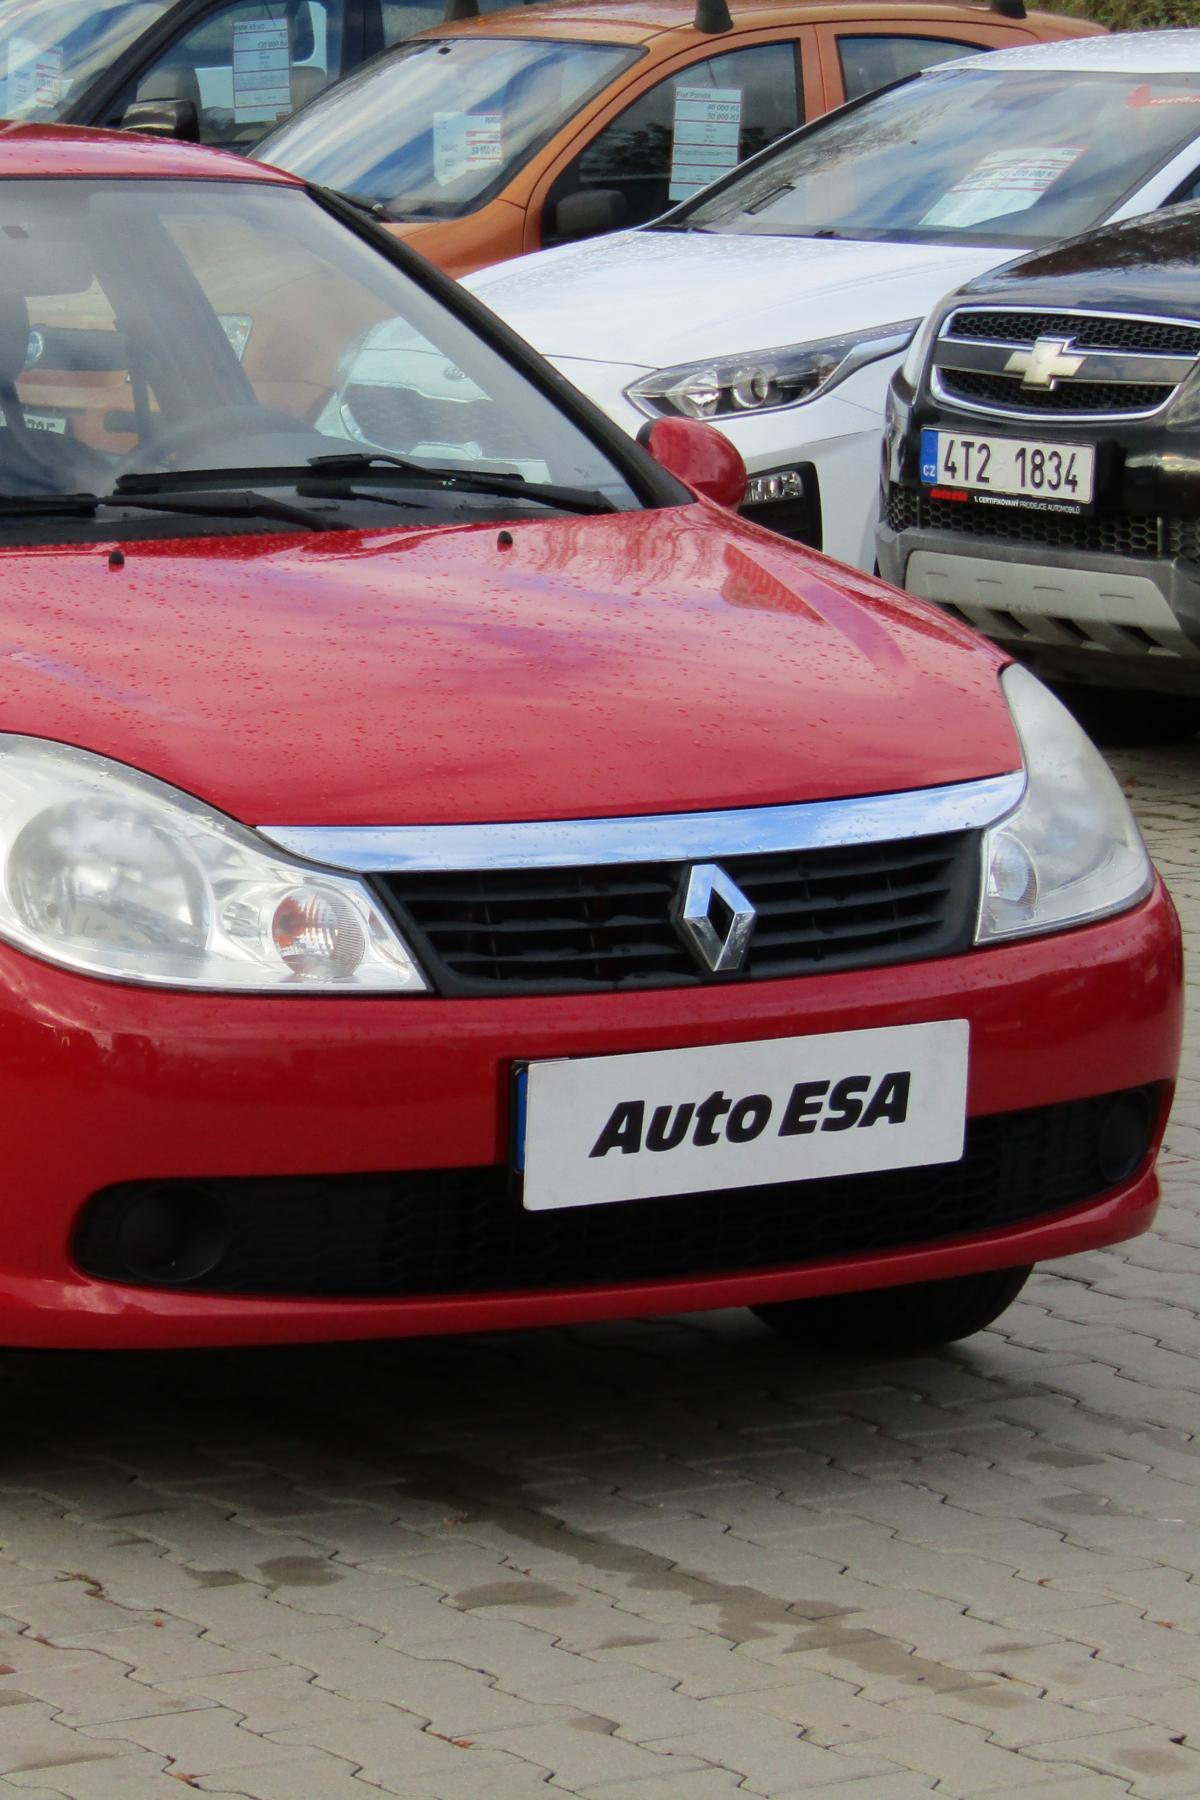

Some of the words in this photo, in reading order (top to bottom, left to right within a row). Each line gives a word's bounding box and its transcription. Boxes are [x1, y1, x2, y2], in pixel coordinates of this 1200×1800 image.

[922, 464, 936, 477] CZ
[943, 439, 991, 484] 4T2
[1014, 447, 1078, 494] 1834
[589, 1091, 772, 1158] Auto
[778, 1071, 911, 1136] ESA
